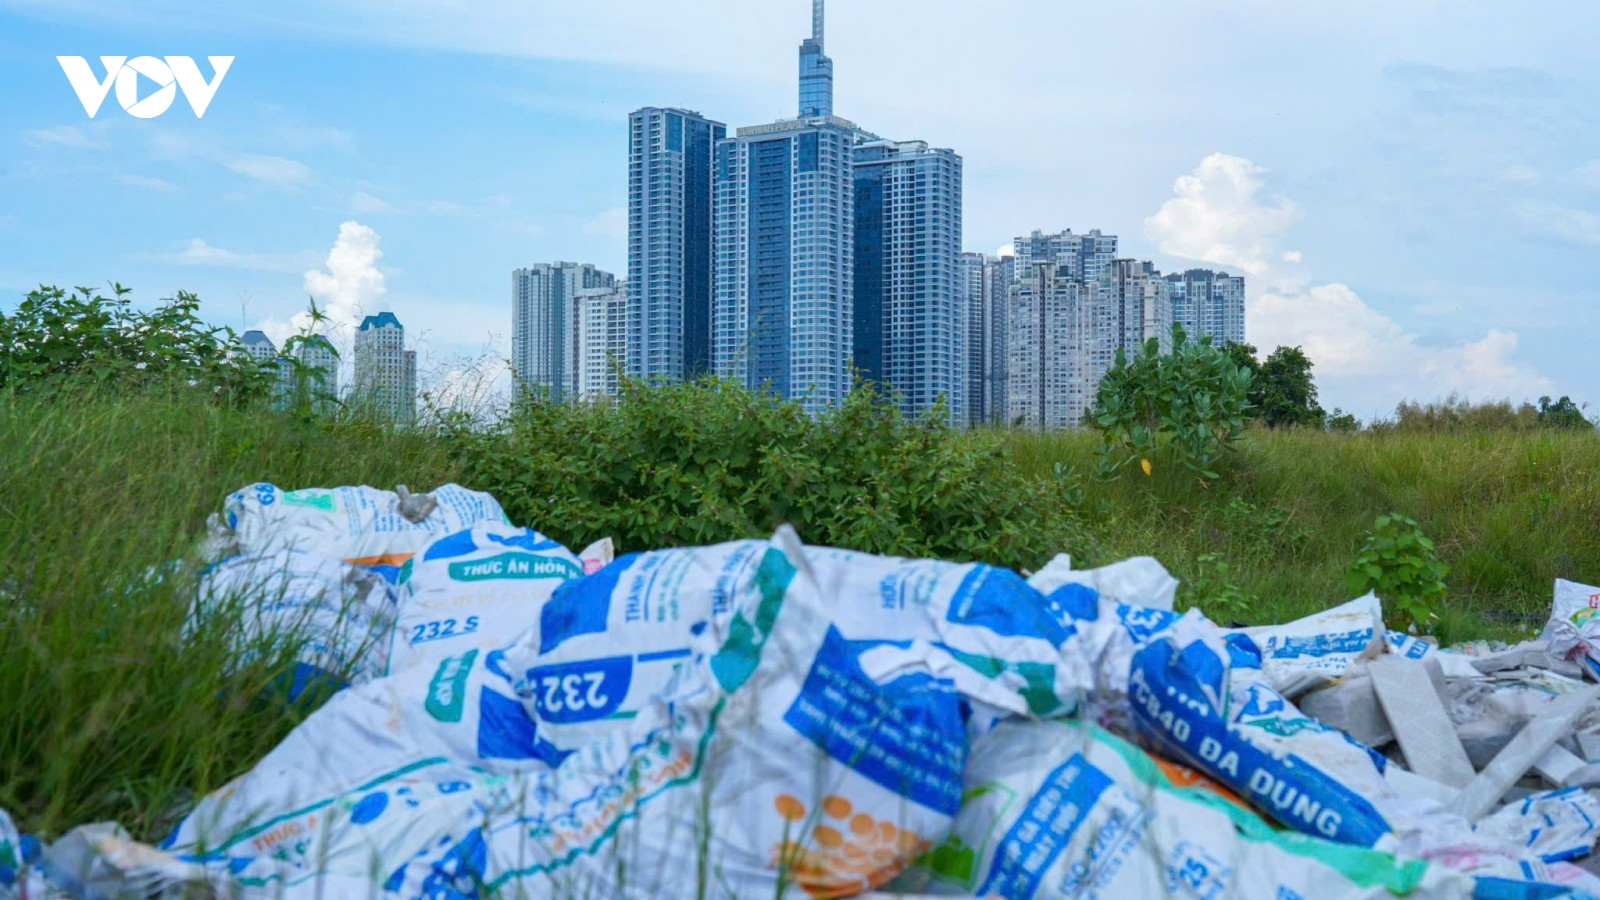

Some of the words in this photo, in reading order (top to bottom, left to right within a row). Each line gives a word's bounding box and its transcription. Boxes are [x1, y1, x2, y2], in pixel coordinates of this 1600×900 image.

[737, 123, 774, 136] SUNWAH
[412, 619, 457, 642] 232
[464, 616, 480, 632] S
